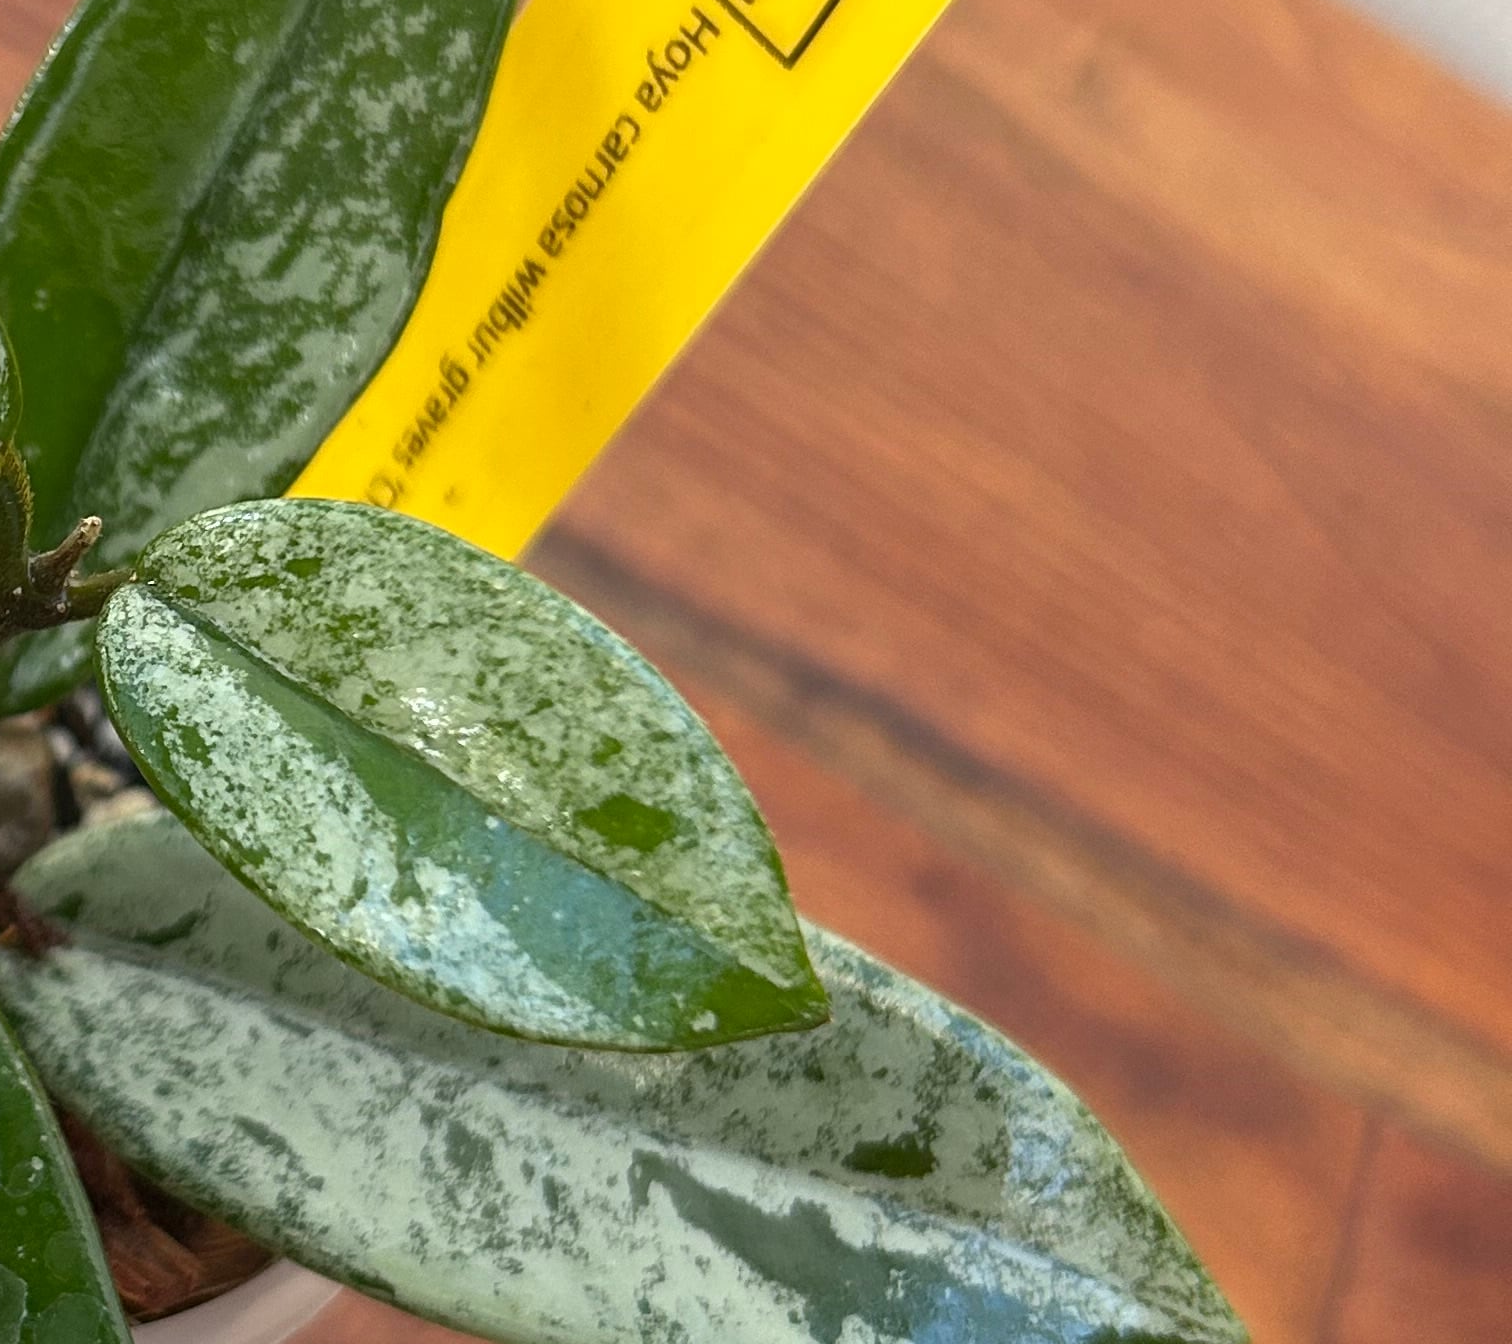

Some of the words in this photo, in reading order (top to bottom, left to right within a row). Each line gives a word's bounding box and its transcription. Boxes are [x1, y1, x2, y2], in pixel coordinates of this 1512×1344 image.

[634, 6, 720, 113] Hoya
[537, 114, 641, 258] carnosa
[468, 256, 547, 370] wilbur
[392, 352, 470, 472] graves
